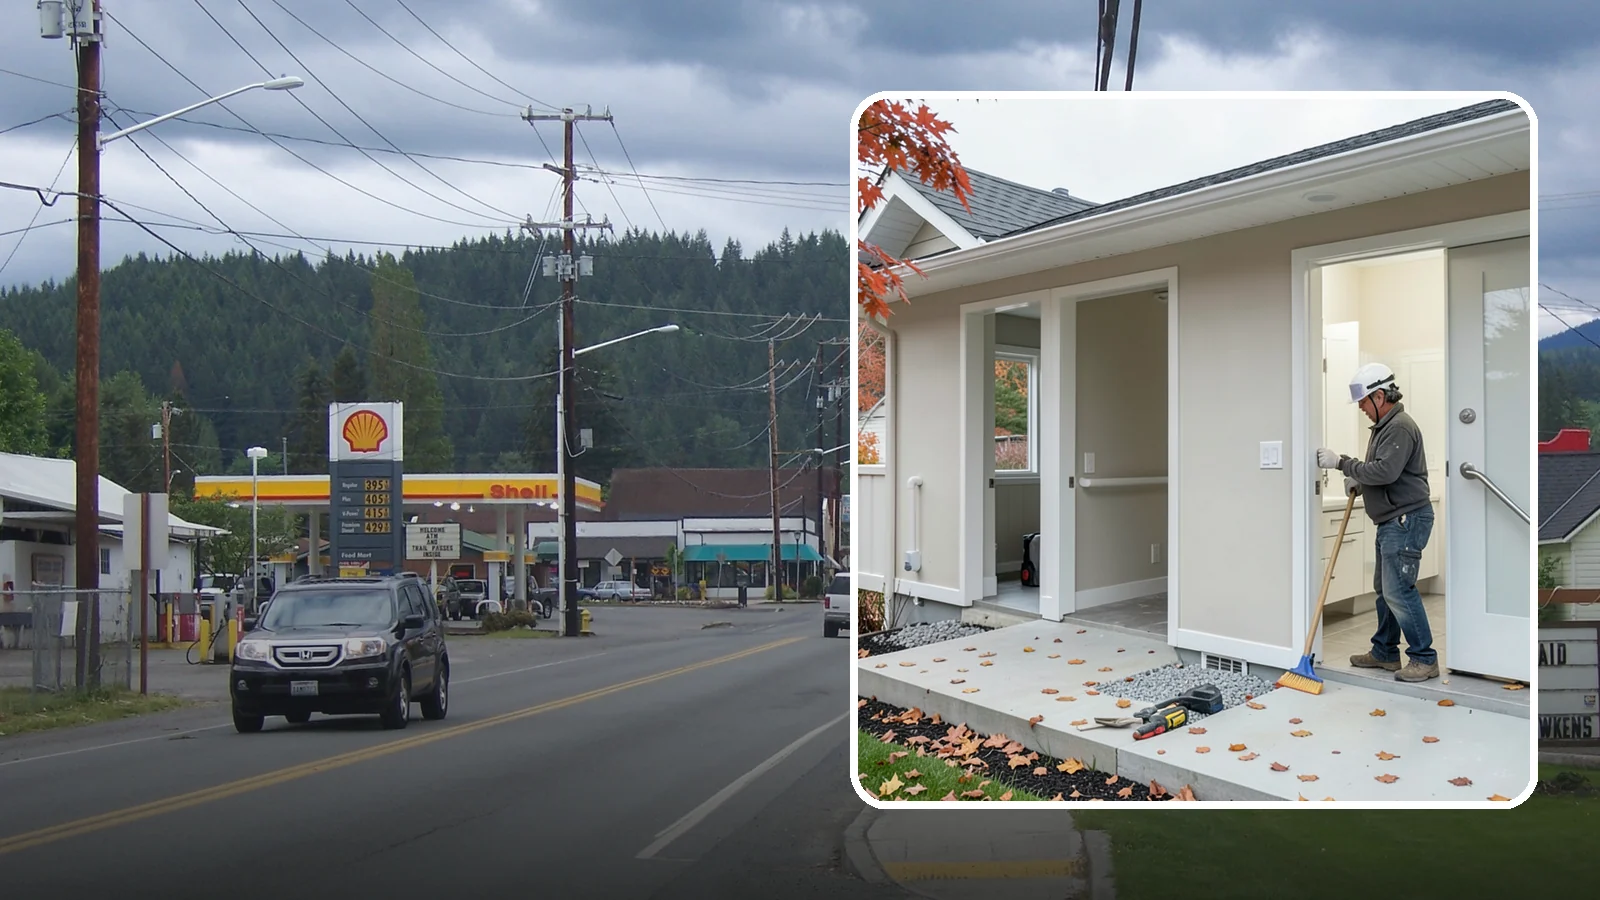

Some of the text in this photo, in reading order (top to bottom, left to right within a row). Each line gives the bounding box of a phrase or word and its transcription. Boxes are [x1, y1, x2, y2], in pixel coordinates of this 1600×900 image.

[366, 480, 383, 490] 395
[490, 484, 547, 499] Shell
[366, 494, 383, 504] 405
[366, 508, 383, 518] 415
[366, 522, 383, 532] 429
[1538, 643, 1566, 665] AID
